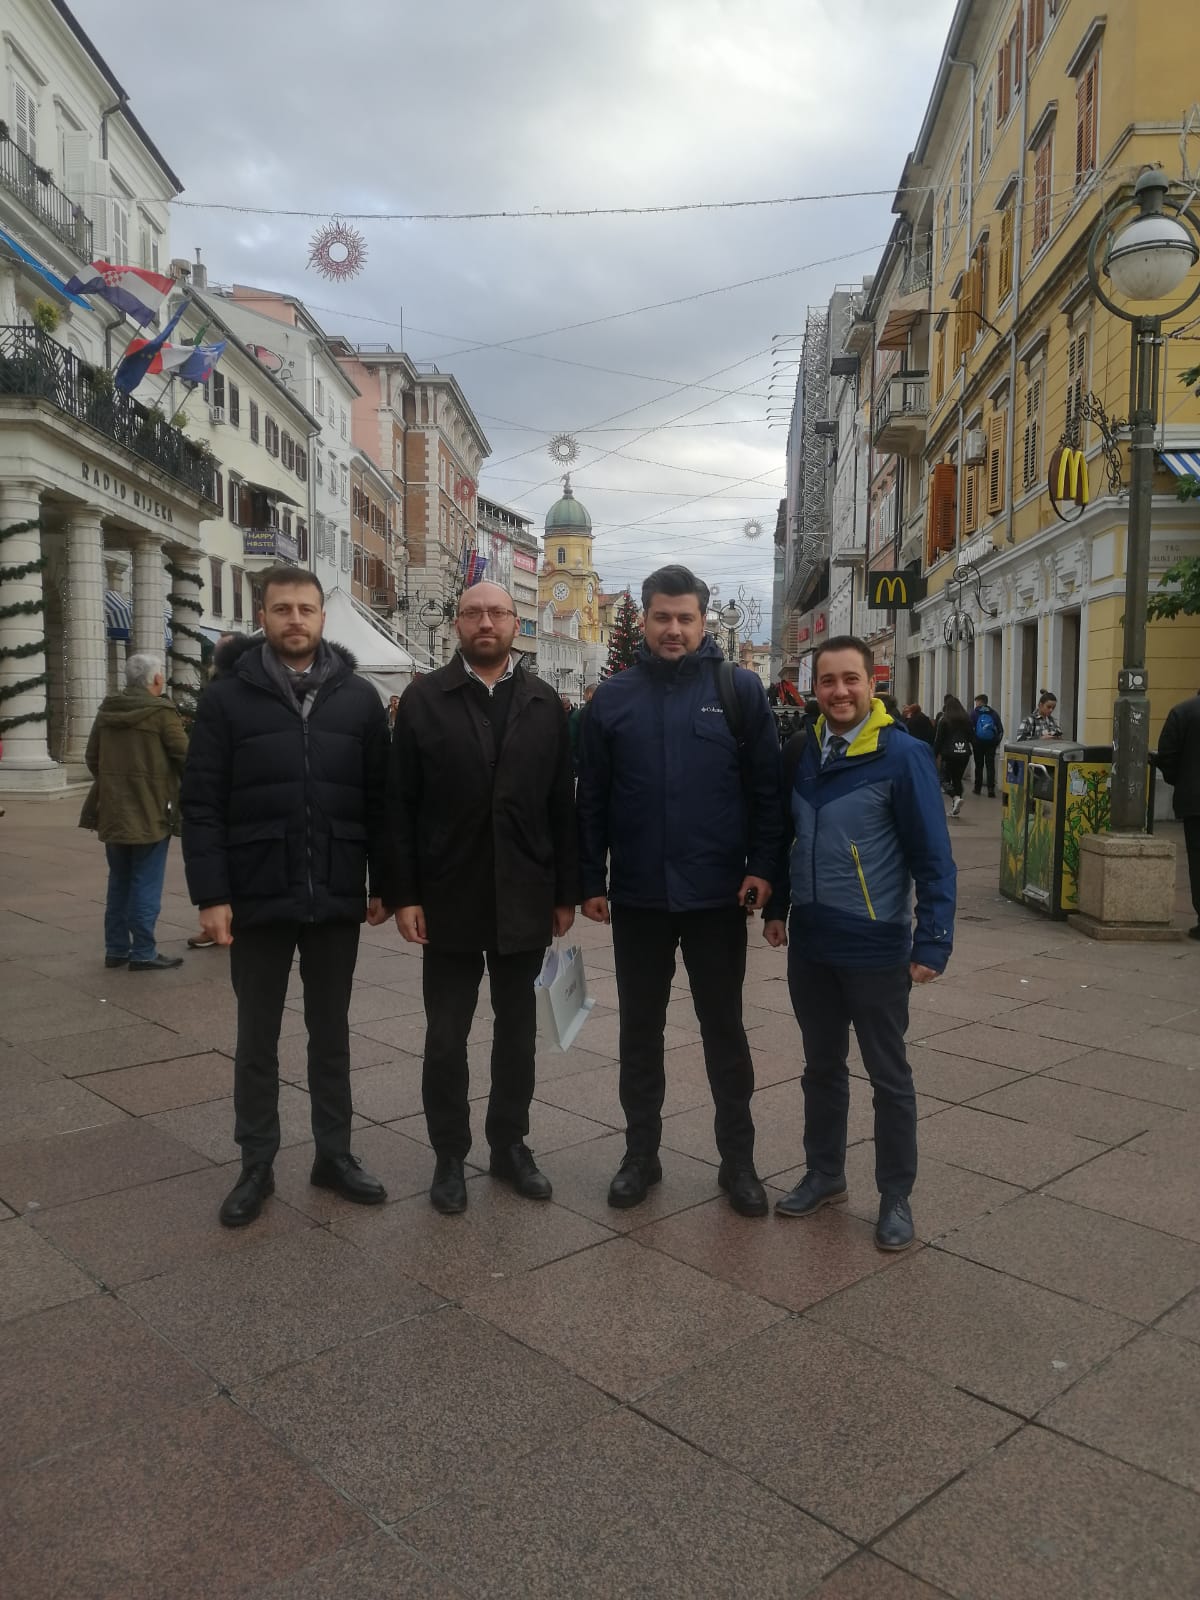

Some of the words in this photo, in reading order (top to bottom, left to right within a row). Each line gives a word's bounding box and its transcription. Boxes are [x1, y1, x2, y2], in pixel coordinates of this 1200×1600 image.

[81, 461, 126, 500] RADIO
[133, 490, 173, 522] RIJEKA
[248, 532, 274, 540] HAPPY
